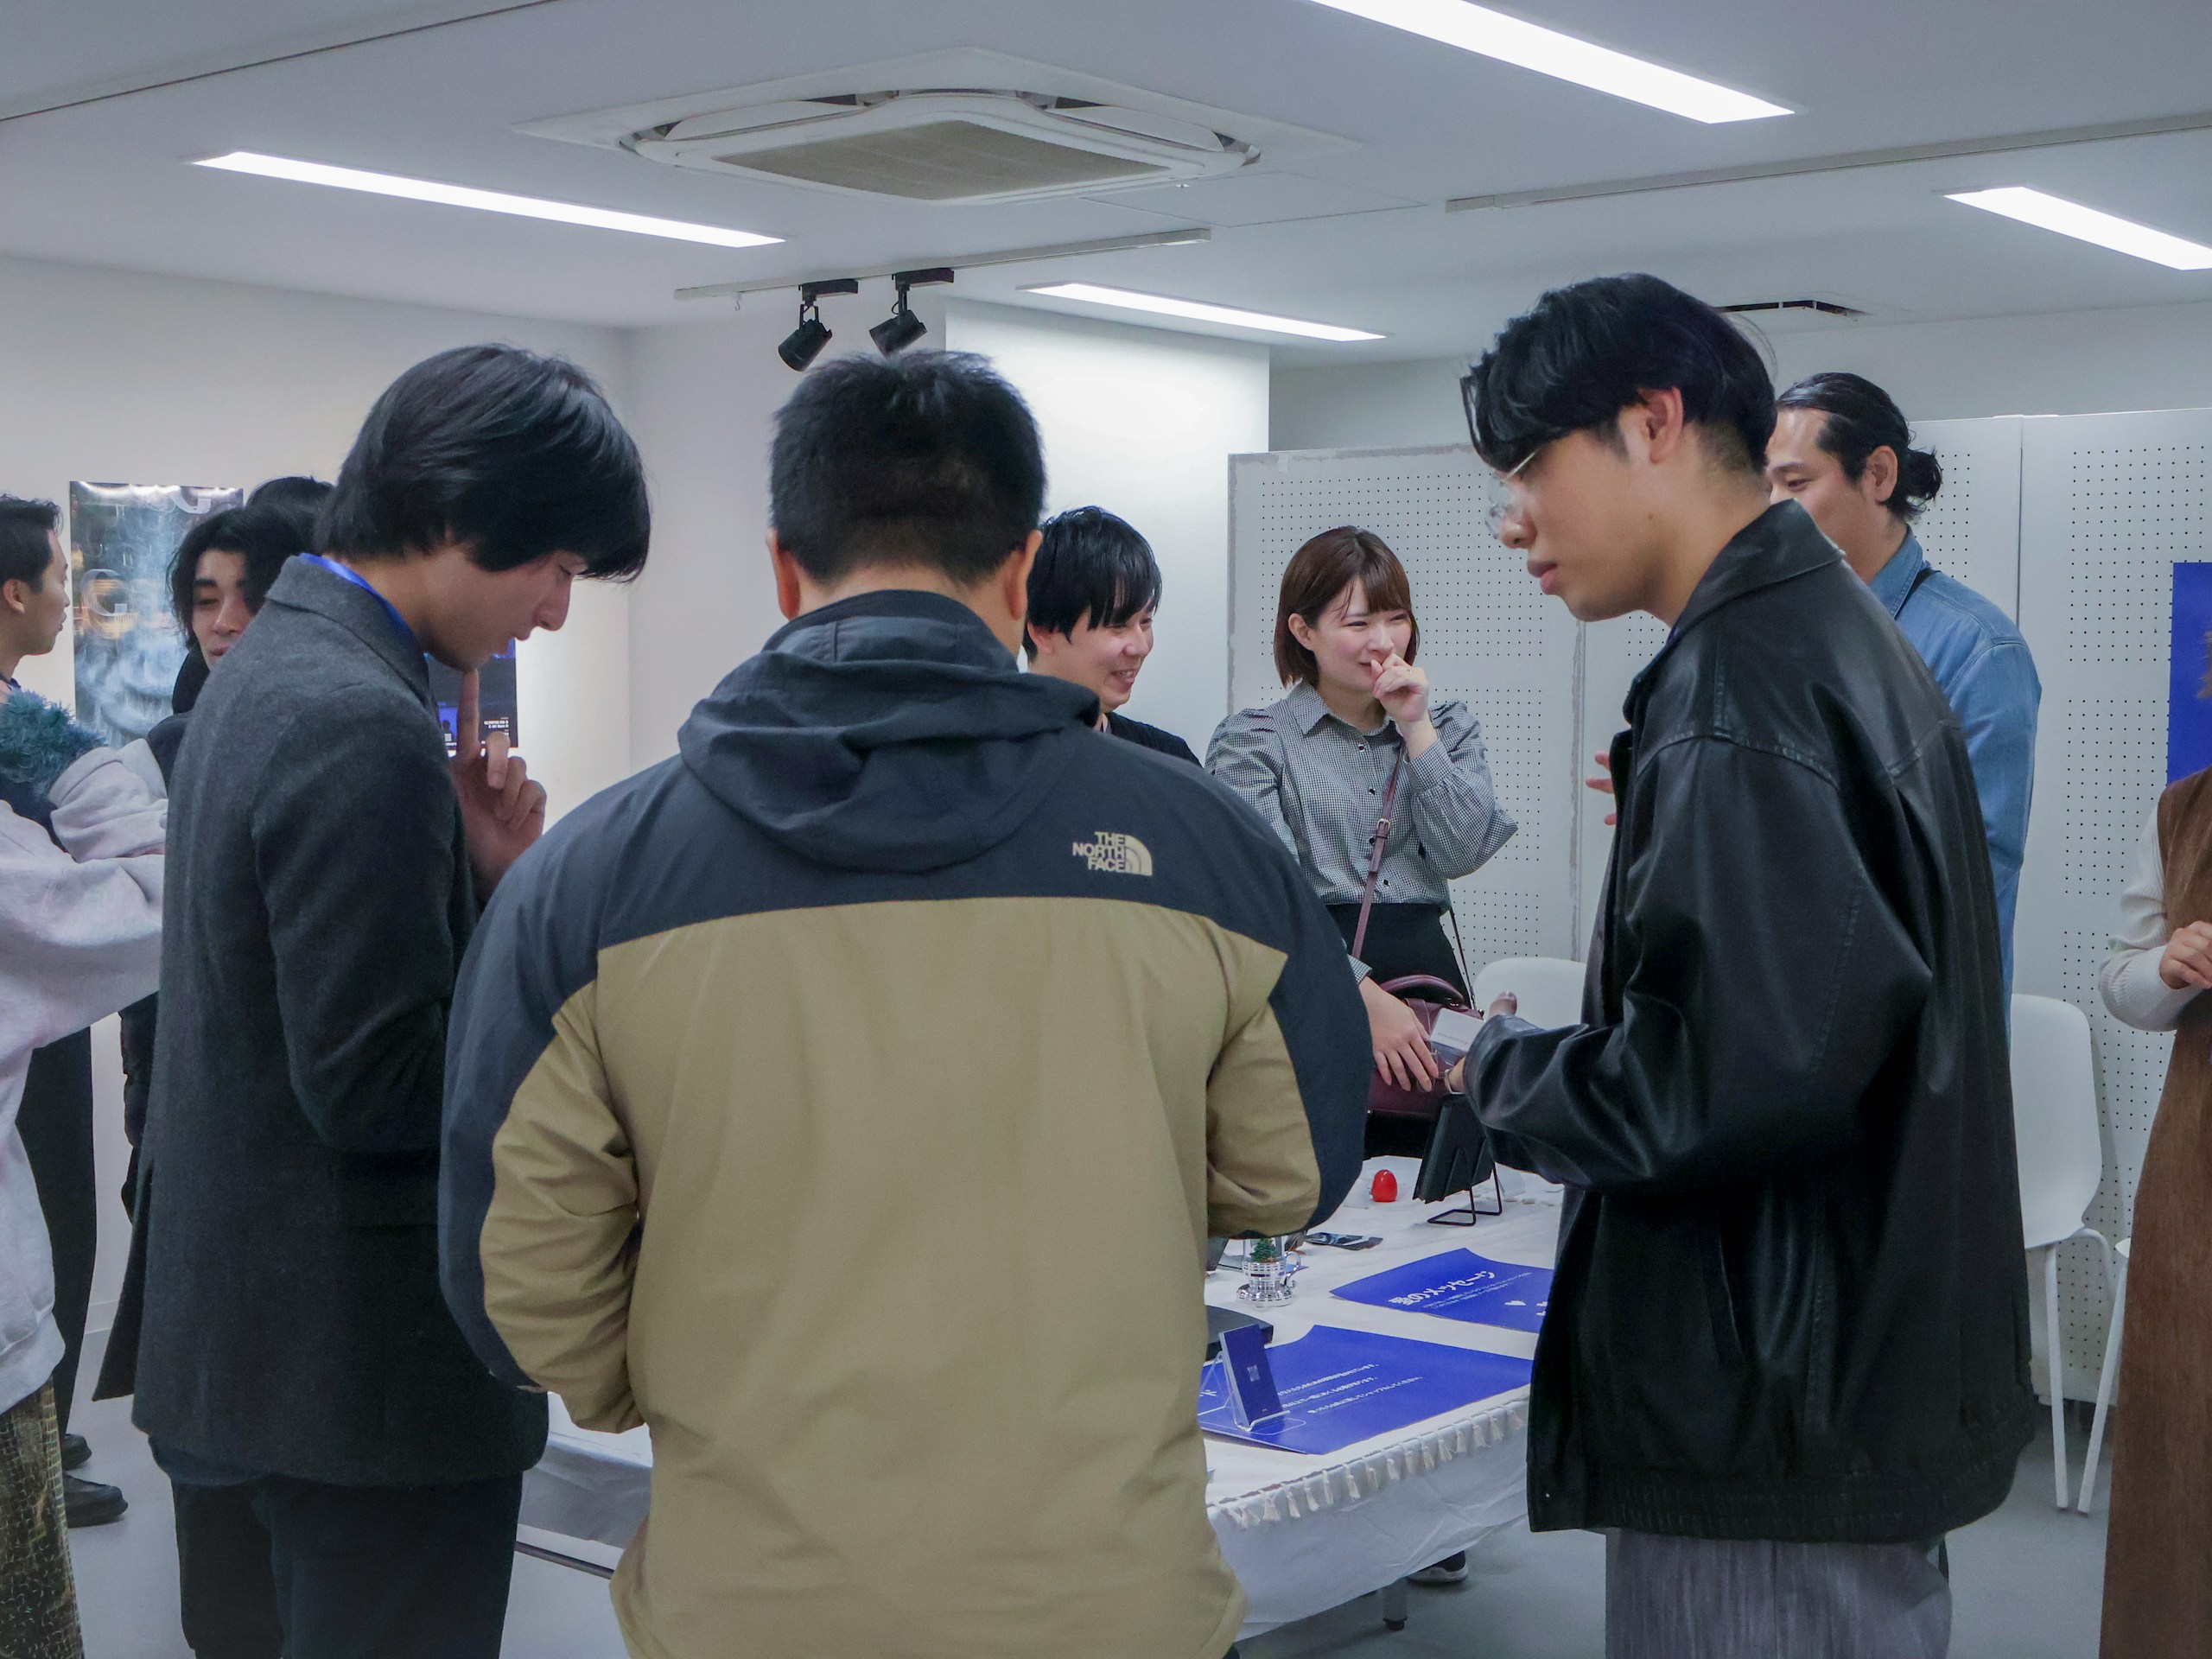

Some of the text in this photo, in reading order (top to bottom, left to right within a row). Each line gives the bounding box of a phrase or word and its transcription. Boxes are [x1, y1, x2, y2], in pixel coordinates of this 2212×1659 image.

[1094, 831, 1125, 846] THE
[1072, 842, 1125, 860] NORTH
[1088, 856, 1125, 873] FACE
